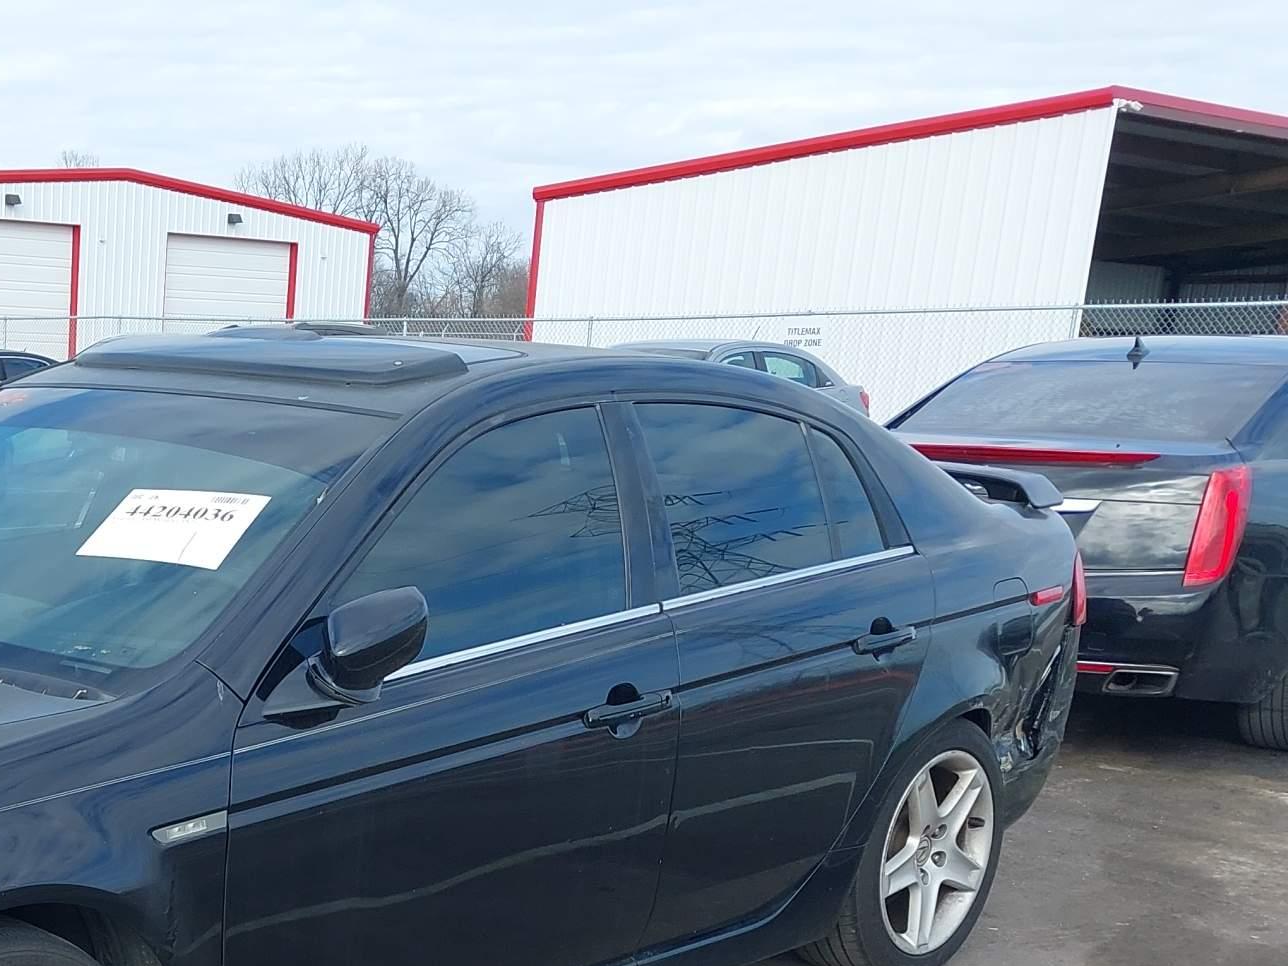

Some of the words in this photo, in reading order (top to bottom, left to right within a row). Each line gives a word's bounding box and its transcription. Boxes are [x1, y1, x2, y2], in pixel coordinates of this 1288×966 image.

[787, 327, 821, 336] TITLEMAX
[783, 339, 803, 347] DROP
[803, 338, 823, 347] ZONE
[126, 504, 238, 523] 44204036
